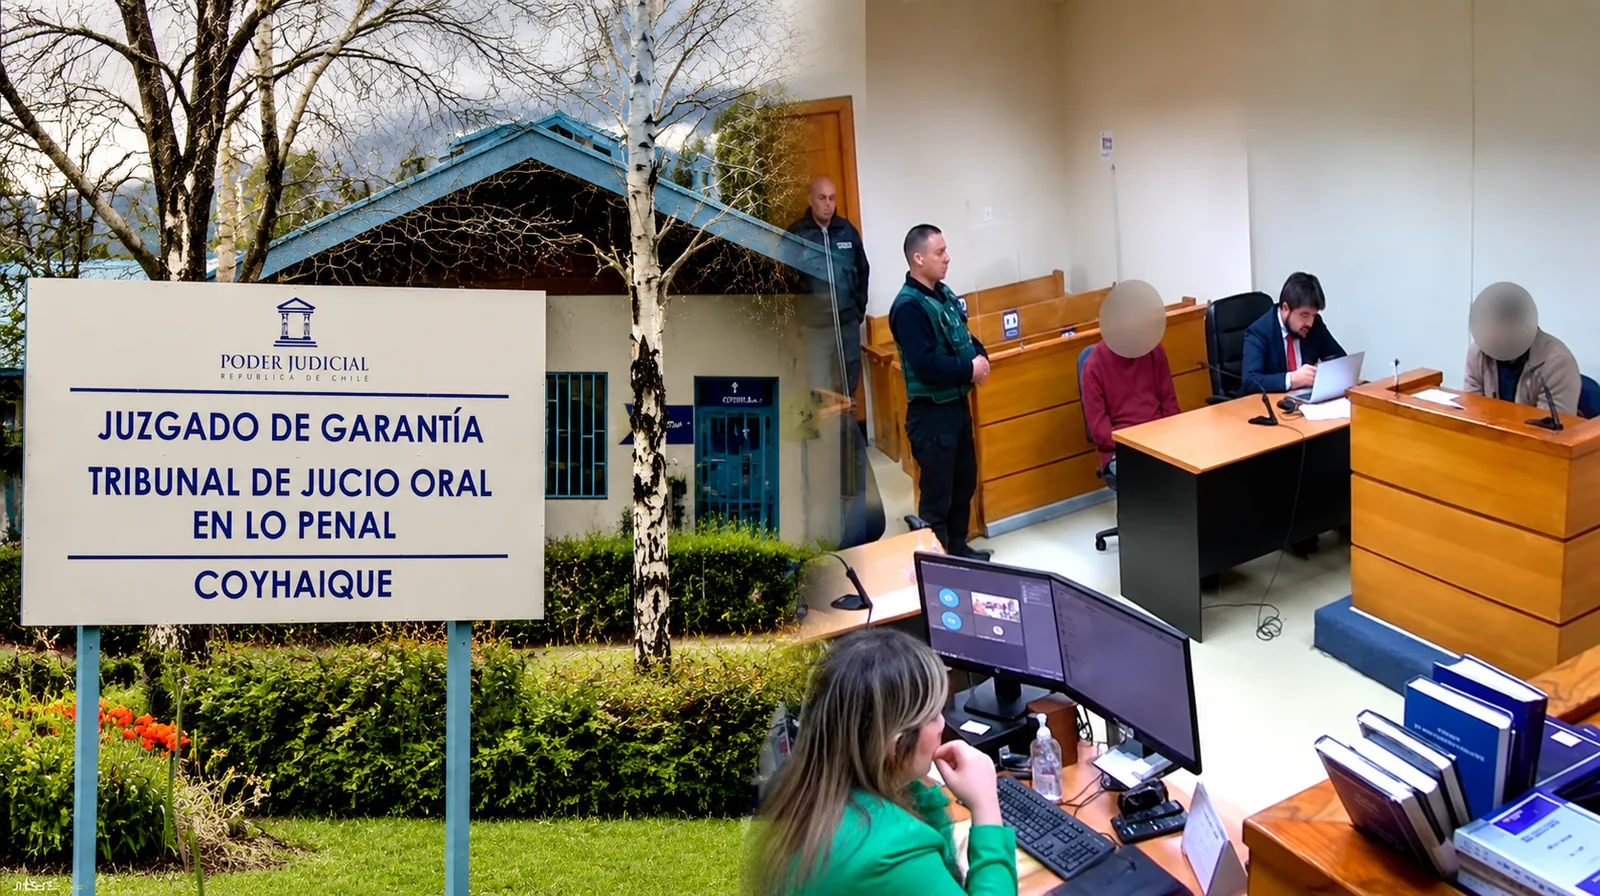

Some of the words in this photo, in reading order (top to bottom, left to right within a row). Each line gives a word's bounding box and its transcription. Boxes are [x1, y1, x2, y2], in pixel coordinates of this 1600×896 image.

[220, 372, 295, 381] REPUBLICA
[306, 374, 321, 382] DE
[331, 374, 369, 383] CHILE
[221, 354, 283, 370] PODER
[287, 355, 370, 373] JUDICIAL
[97, 410, 260, 442] JUZGADO
[271, 412, 310, 442] DE
[320, 406, 484, 443] GARANTÍA
[88, 466, 241, 497] TRIBUNAL
[251, 467, 291, 497] DE
[300, 467, 400, 498] JUCIO
[410, 468, 493, 498] ORAL
[193, 510, 233, 540] EN
[245, 509, 287, 540] LO
[298, 510, 397, 540] PENAL
[194, 569, 393, 601] COYHAIQUE
